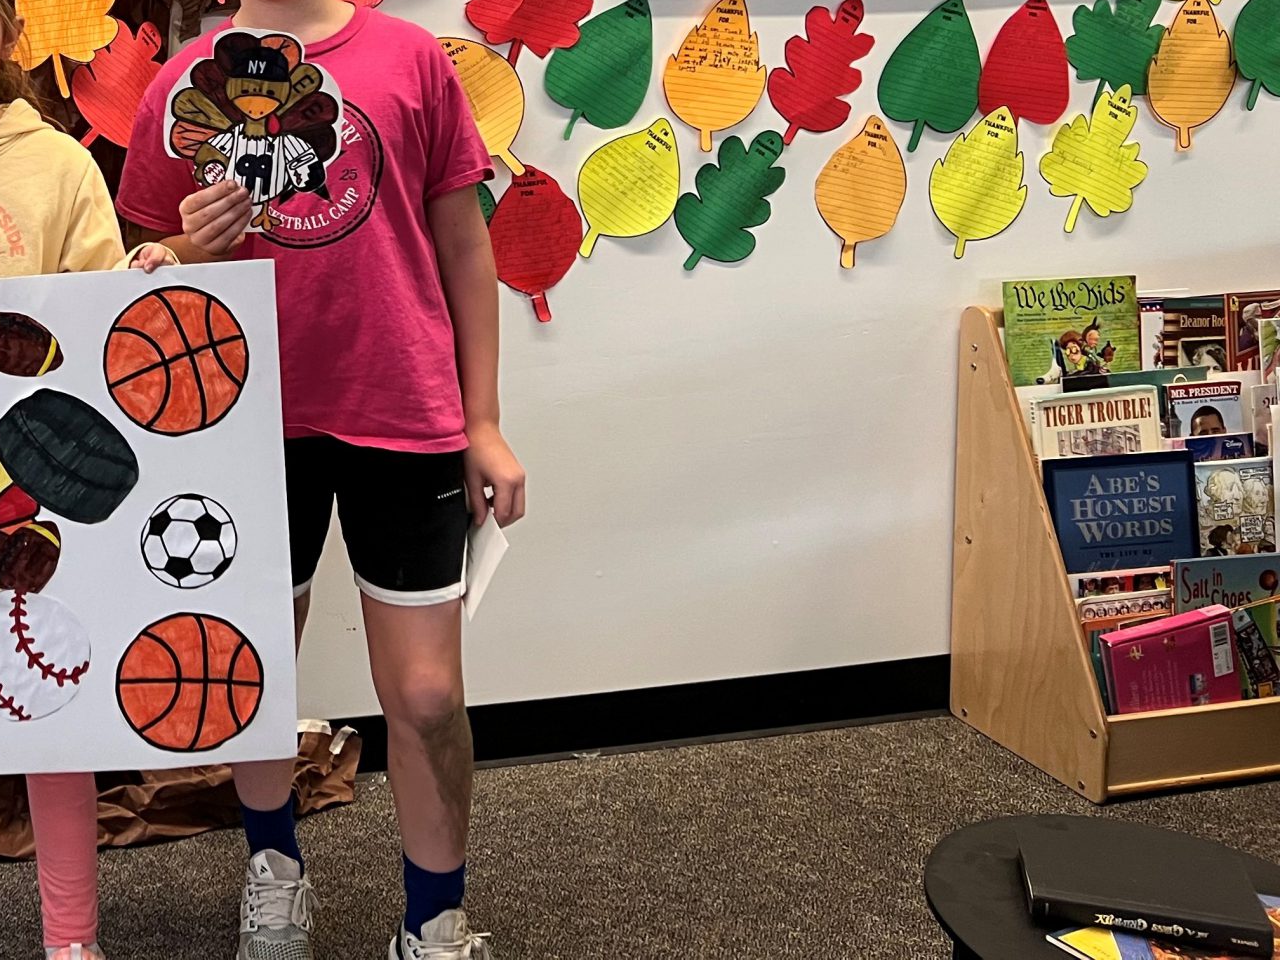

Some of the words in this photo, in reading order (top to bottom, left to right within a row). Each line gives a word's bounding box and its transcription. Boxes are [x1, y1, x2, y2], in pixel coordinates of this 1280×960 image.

[248, 60, 267, 74] NY
[985, 120, 1013, 134] THANKFUL
[340, 169, 358, 181] 25
[329, 188, 359, 219] CAMP
[1013, 286, 1046, 309] We
[1050, 282, 1076, 311] the
[1074, 280, 1125, 315] Kids
[1180, 315, 1211, 327] Eleanor
[1171, 389, 1188, 398] MR.
[1189, 385, 1238, 397] PRESIDENT
[1043, 404, 1084, 427] TIGER
[1088, 397, 1152, 424] TROUBLE!
[1084, 471, 1160, 496] ABE'S
[1070, 496, 1176, 521] HONEST
[1076, 518, 1174, 544] WORDS
[1182, 567, 1209, 604] Salt
[1213, 568, 1223, 586] in
